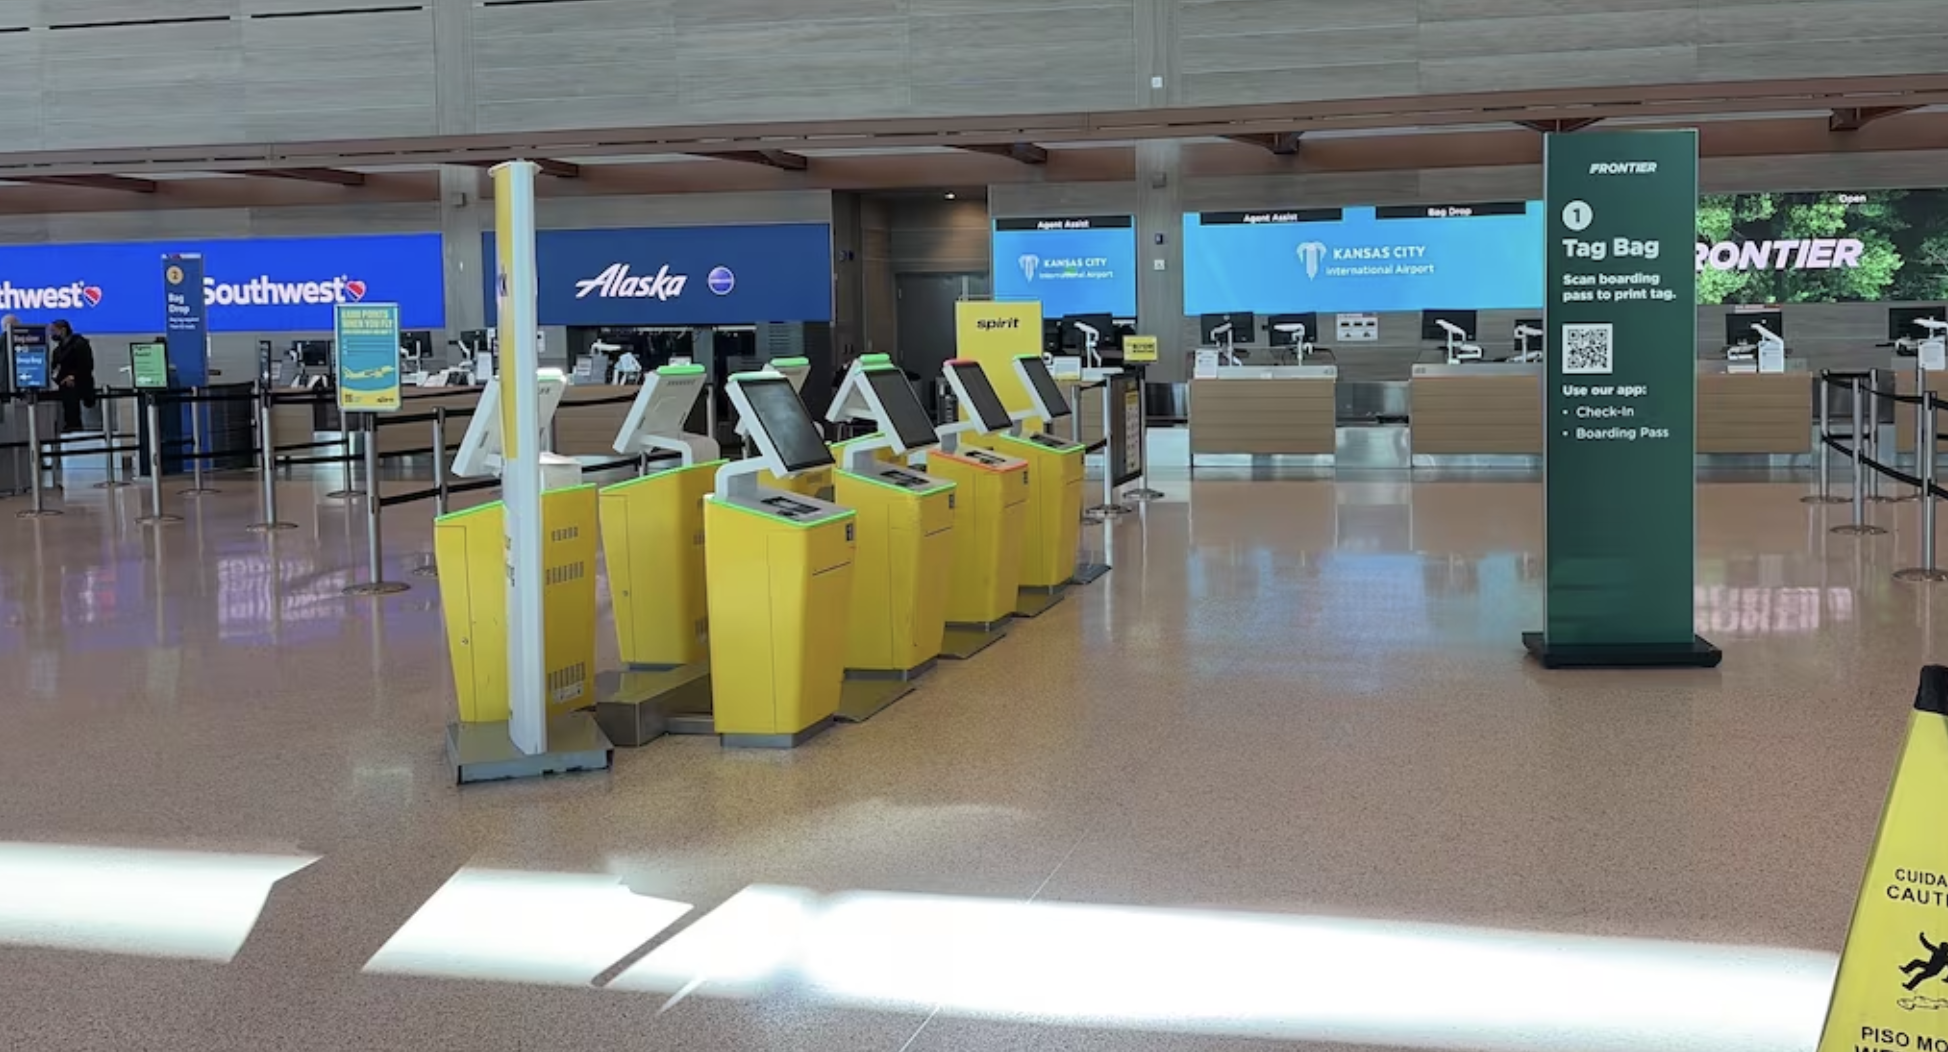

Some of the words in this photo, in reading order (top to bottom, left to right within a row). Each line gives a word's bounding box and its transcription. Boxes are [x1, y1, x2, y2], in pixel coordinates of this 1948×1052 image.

[1589, 162, 1657, 175] FRONTIER
[1839, 194, 1867, 204] Open
[1243, 214, 1271, 224] Agent
[1272, 212, 1298, 222] Assist
[1428, 208, 1447, 217] Bag
[1449, 206, 1473, 216] Drop
[1572, 208, 1581, 223] 1
[1037, 221, 1063, 230] Agent
[1064, 219, 1090, 228] Assist
[1333, 246, 1390, 259] KANSAS
[1393, 245, 1425, 258] CITY
[1562, 238, 1608, 260] Tag
[1613, 238, 1660, 260] Bag
[1044, 258, 1083, 268] KANSAS
[1085, 257, 1107, 267] CITY
[1326, 264, 1394, 277] International
[1395, 264, 1434, 276] Airport
[575, 263, 687, 301] Alaska
[1563, 274, 1596, 285] Scan
[1599, 273, 1660, 286] boarding
[203, 274, 346, 305] Southwest
[1563, 290, 1593, 302] pass
[1597, 289, 1611, 301] to
[1614, 288, 1647, 302] print
[1650, 288, 1677, 301] tag.
[976, 318, 1019, 331] spirit
[1563, 385, 1588, 396] Use
[1591, 386, 1614, 396] our
[1617, 386, 1647, 398] app:
[1576, 406, 1635, 417] Check-In
[1576, 427, 1636, 440] Boarding
[1640, 427, 1670, 438] Pass
[1895, 868, 1948, 887] CUIDA
[1861, 1026, 1910, 1047] PISO
[1917, 1035, 1948, 1052] MO
